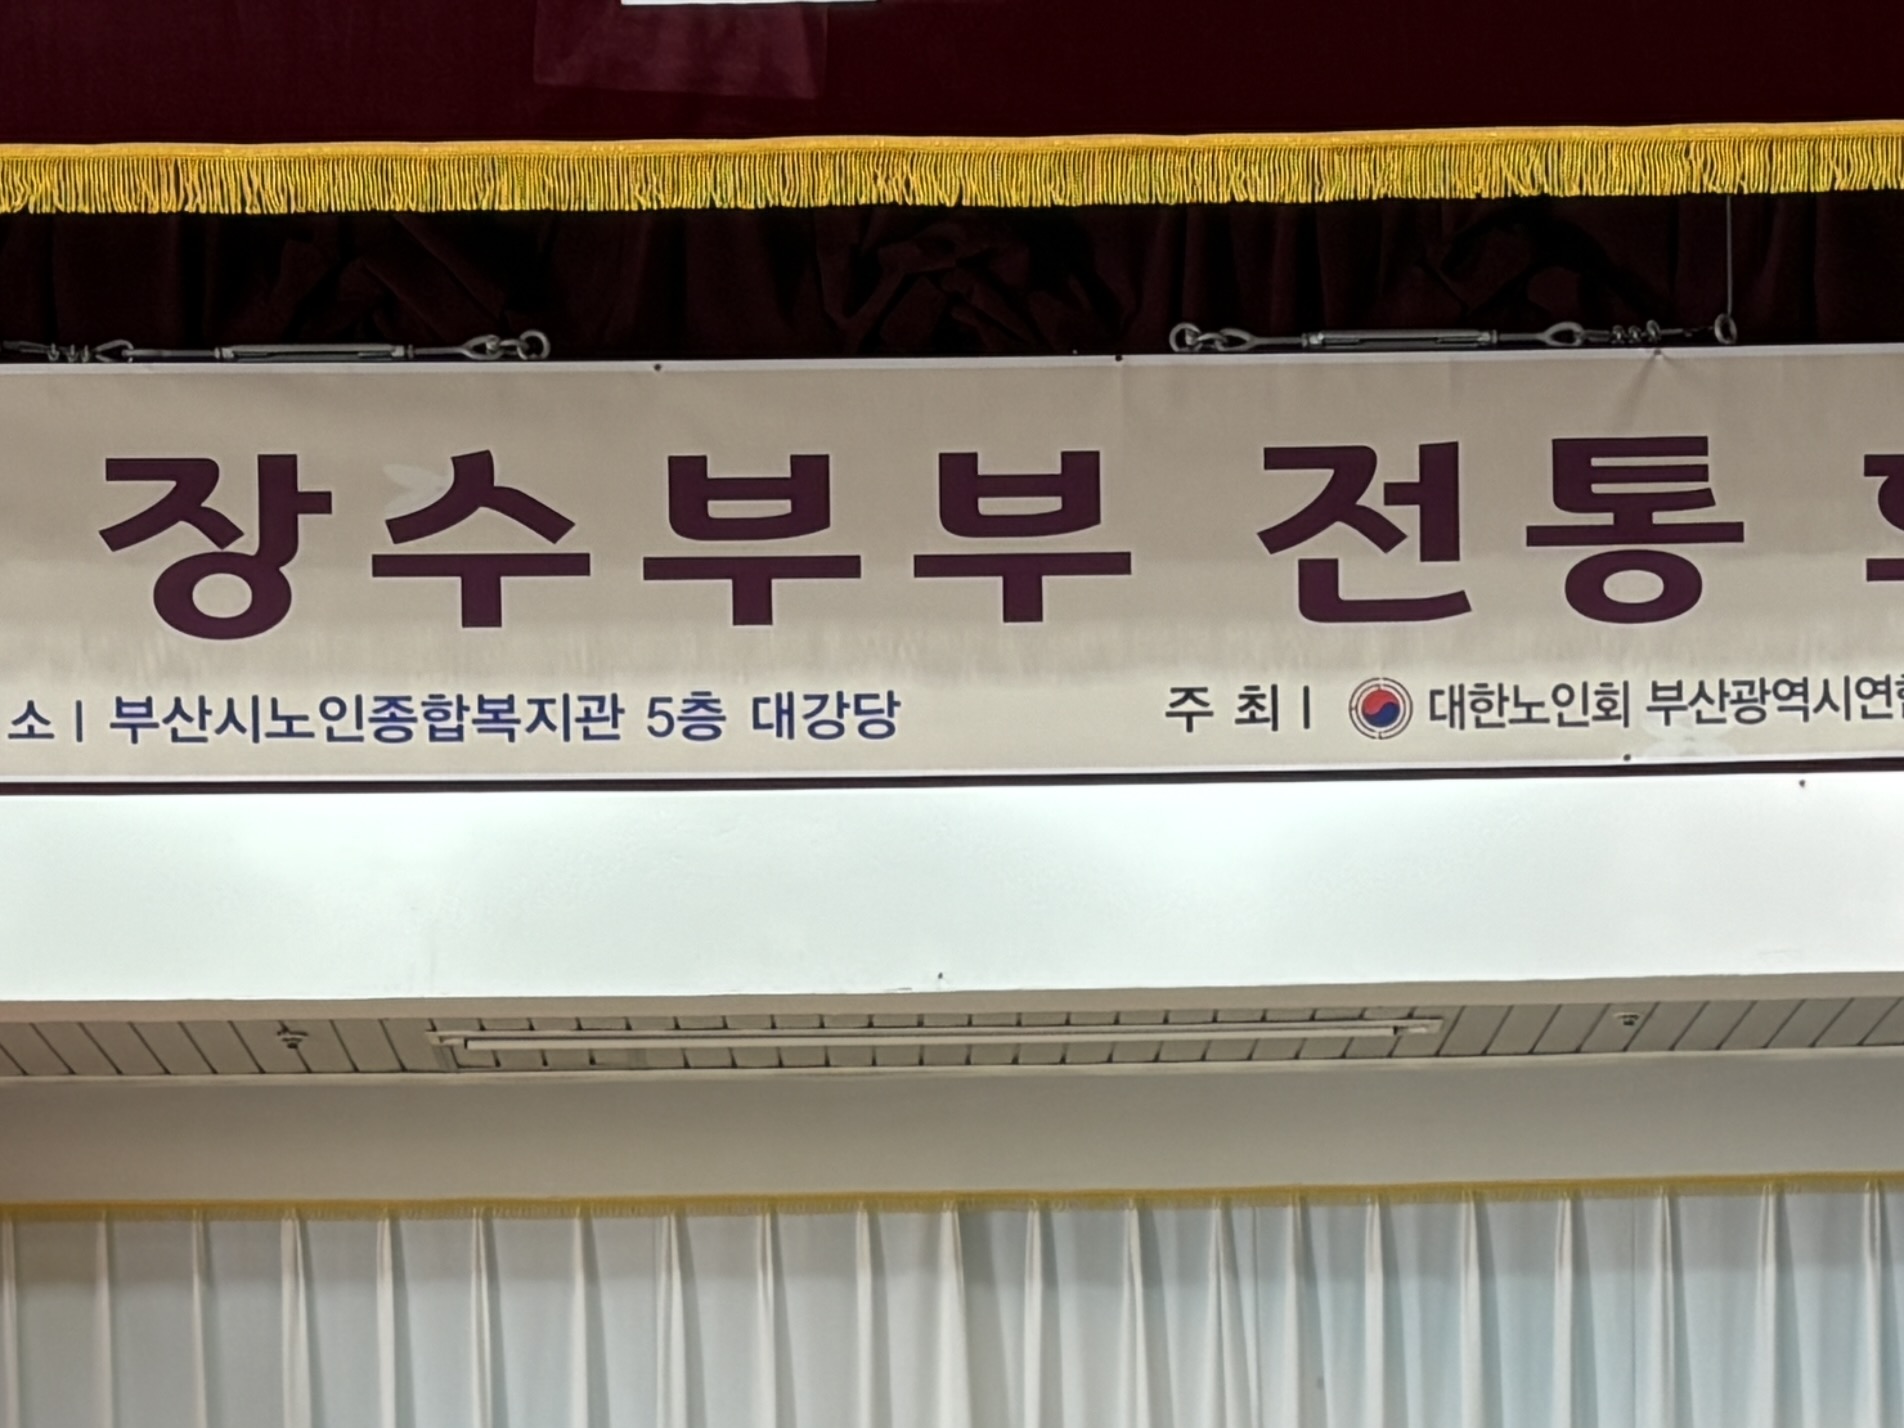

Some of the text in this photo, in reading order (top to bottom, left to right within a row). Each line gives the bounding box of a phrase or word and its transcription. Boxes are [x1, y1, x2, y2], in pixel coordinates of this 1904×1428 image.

[99, 450, 1131, 640] 장수부부
[1257, 436, 1744, 624] 전통
[110, 693, 625, 744] 부산시노인종합복지관
[648, 691, 726, 741] 5층
[753, 690, 901, 740] 대강당
[1430, 681, 1629, 730] 대한노인회
